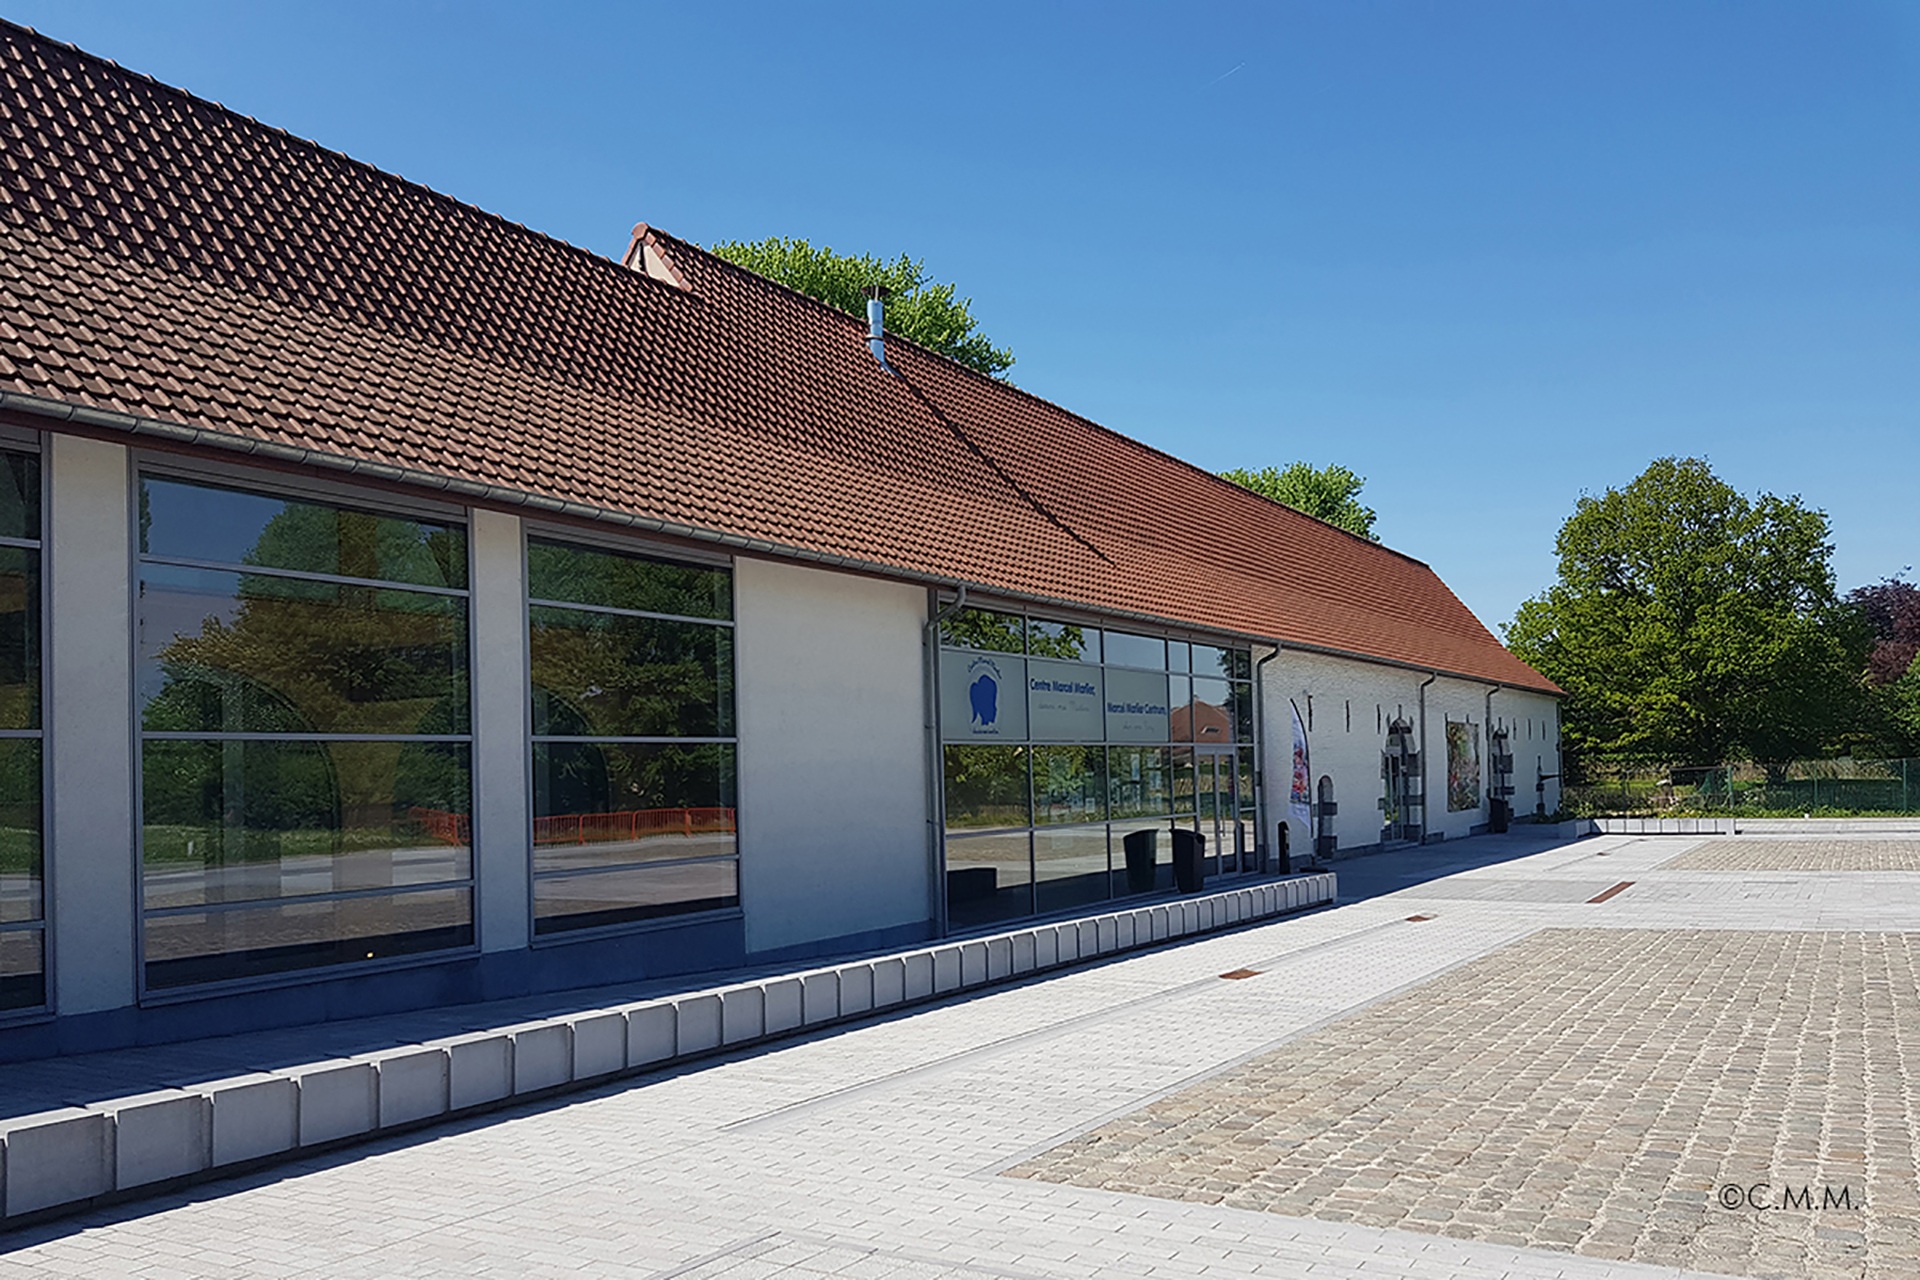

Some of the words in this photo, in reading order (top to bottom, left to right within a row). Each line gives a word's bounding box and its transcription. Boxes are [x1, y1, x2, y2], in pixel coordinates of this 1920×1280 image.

[1030, 678, 1051, 692] Centre
[1052, 680, 1073, 693] Marcel
[1107, 702, 1125, 713] Marcel
